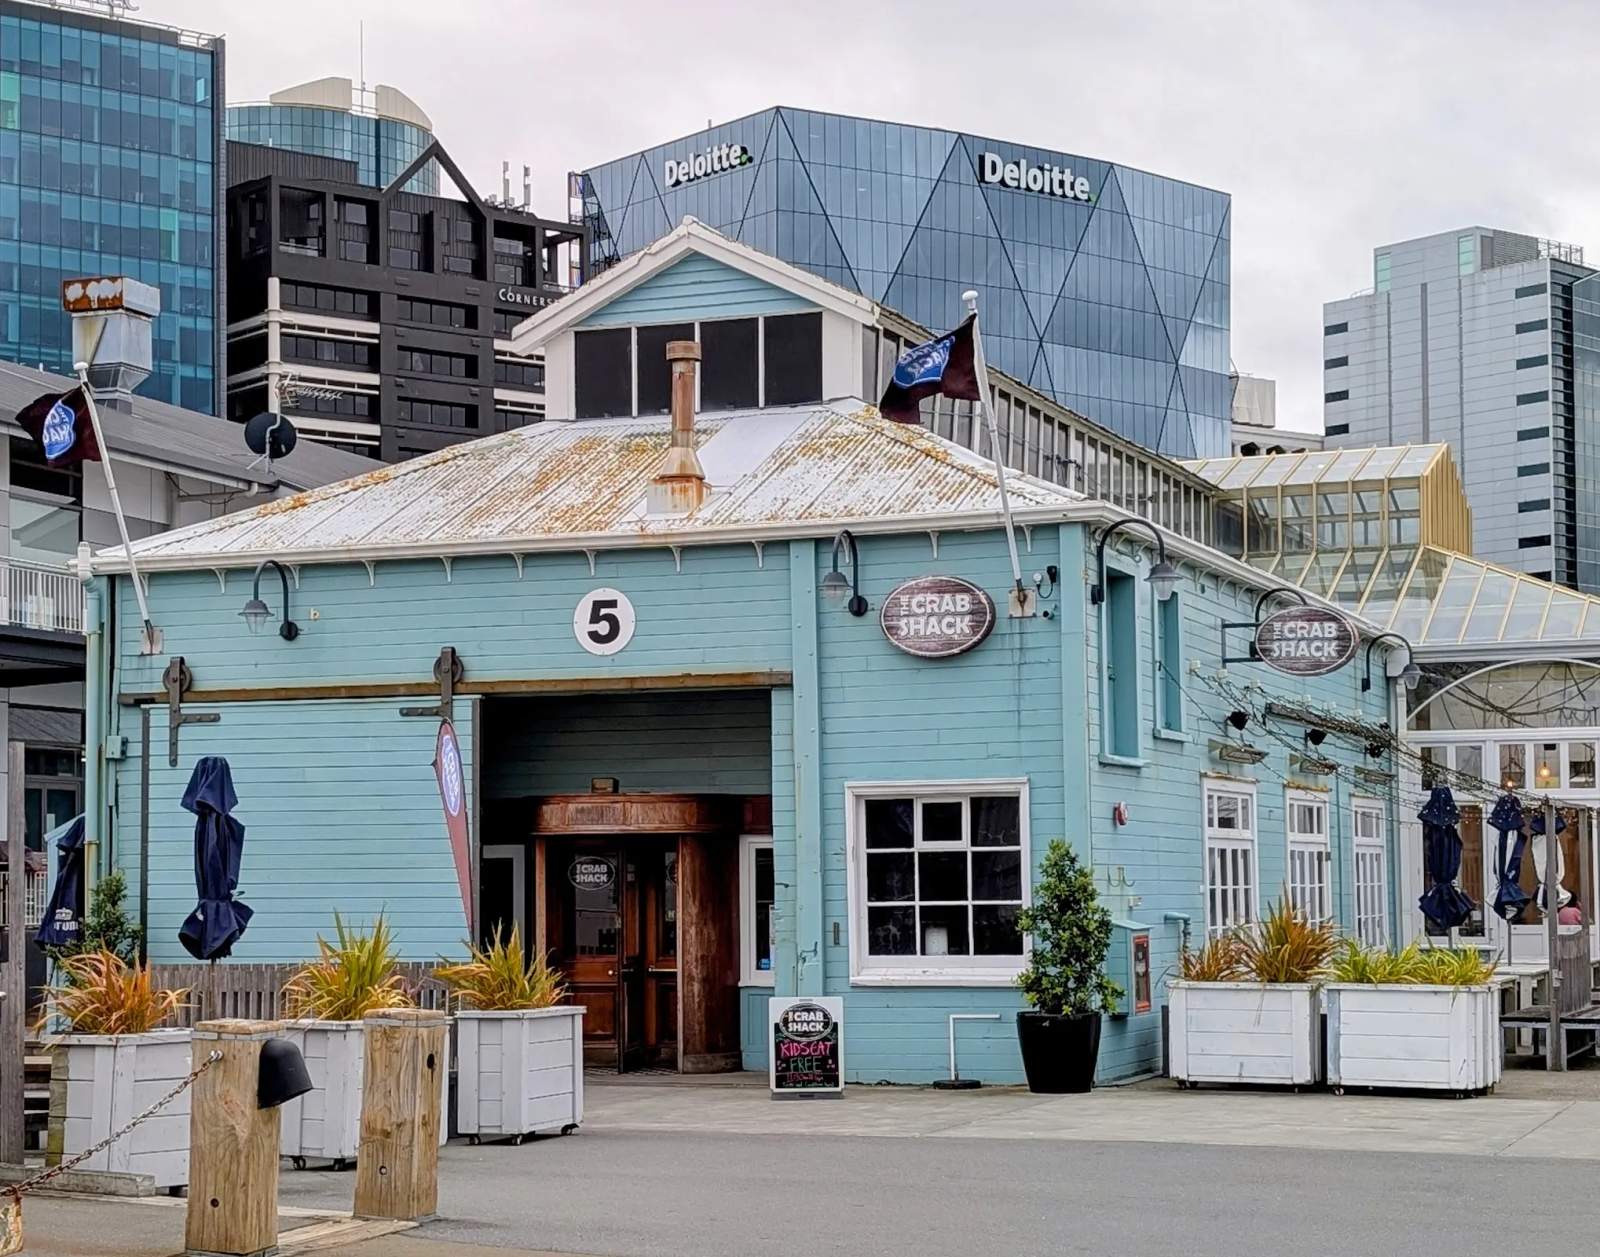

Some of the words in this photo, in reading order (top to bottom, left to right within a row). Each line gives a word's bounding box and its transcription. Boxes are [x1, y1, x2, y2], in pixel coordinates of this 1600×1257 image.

[498, 285, 557, 307] CORNERS
[900, 594, 910, 616] THE
[911, 593, 971, 614] CRAB
[587, 599, 620, 644] 5
[898, 615, 971, 636] SHACK
[1272, 622, 1282, 640] THE
[1283, 621, 1338, 638] CRAB
[1270, 640, 1339, 657] SHACK
[581, 864, 608, 873] CRAB
[575, 873, 608, 883] SHACK
[794, 1011, 824, 1021] CRAB
[788, 1022, 825, 1032] SHACK
[780, 1041, 810, 1057] KIDS
[810, 1041, 833, 1056] EAT
[790, 1056, 823, 1073] FREE
